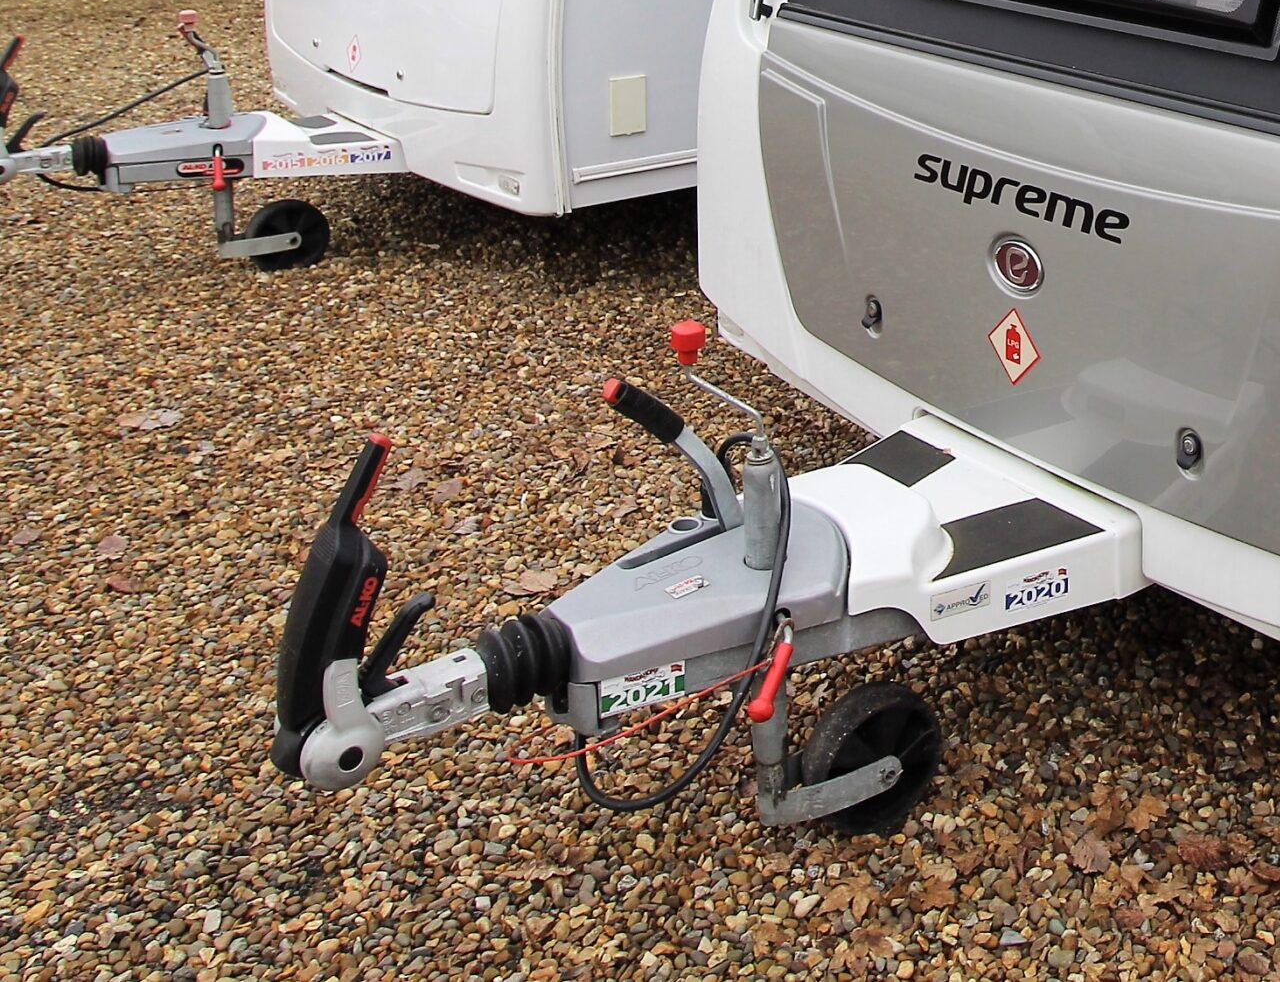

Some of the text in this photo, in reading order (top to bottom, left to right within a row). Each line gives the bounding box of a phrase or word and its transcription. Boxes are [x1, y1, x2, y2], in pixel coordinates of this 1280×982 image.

[354, 150, 388, 164] 2017
[914, 153, 1130, 245] supreme
[1007, 338, 1020, 350] LPG
[1006, 578, 1067, 611] 2020
[607, 676, 685, 713] 2021
